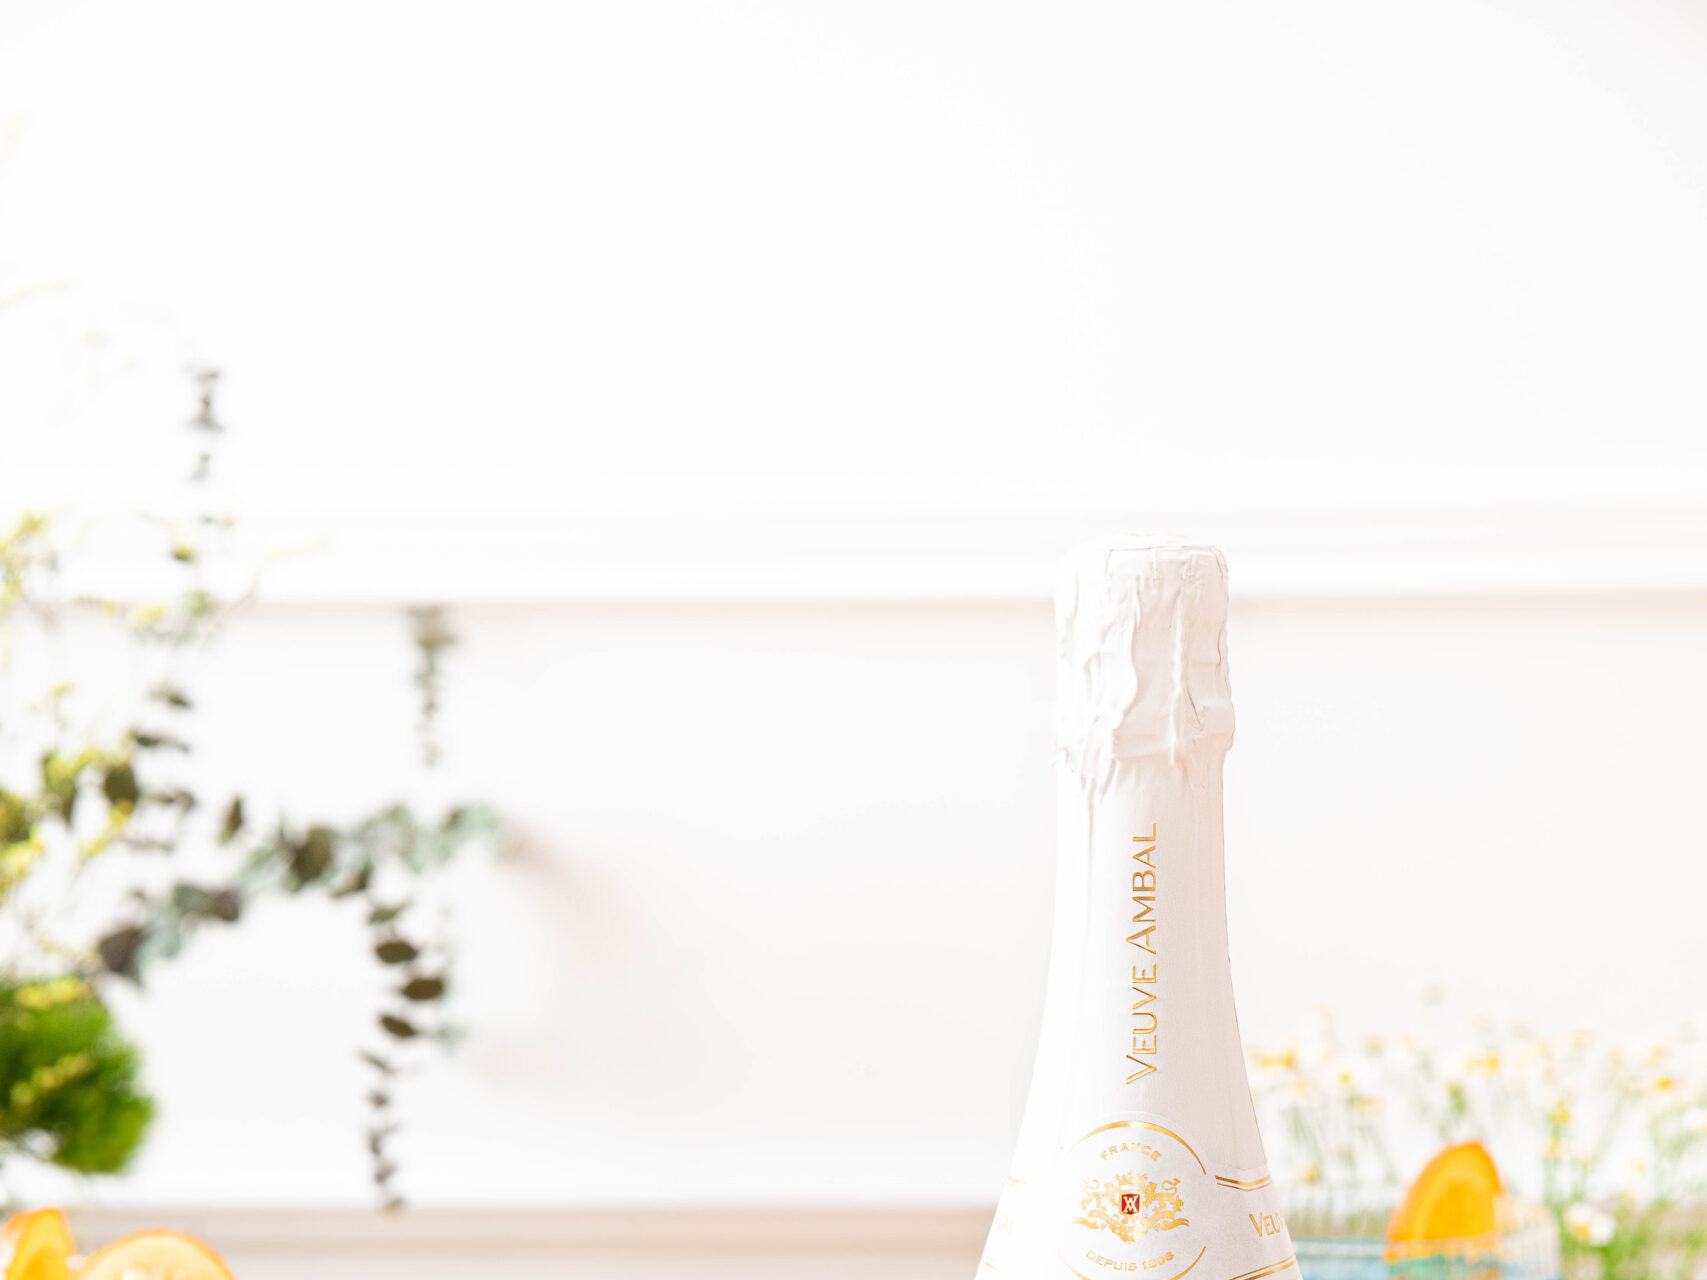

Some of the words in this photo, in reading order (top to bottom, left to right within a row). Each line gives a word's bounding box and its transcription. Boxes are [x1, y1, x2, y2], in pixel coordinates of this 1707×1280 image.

[1126, 823, 1157, 955] AMBAL
[1126, 963, 1157, 1085] VEUVE
[1100, 1142, 1162, 1162] FRANCE
[1248, 1211, 1283, 1238] VEU
[1085, 1250, 1137, 1271] DEPUIS
